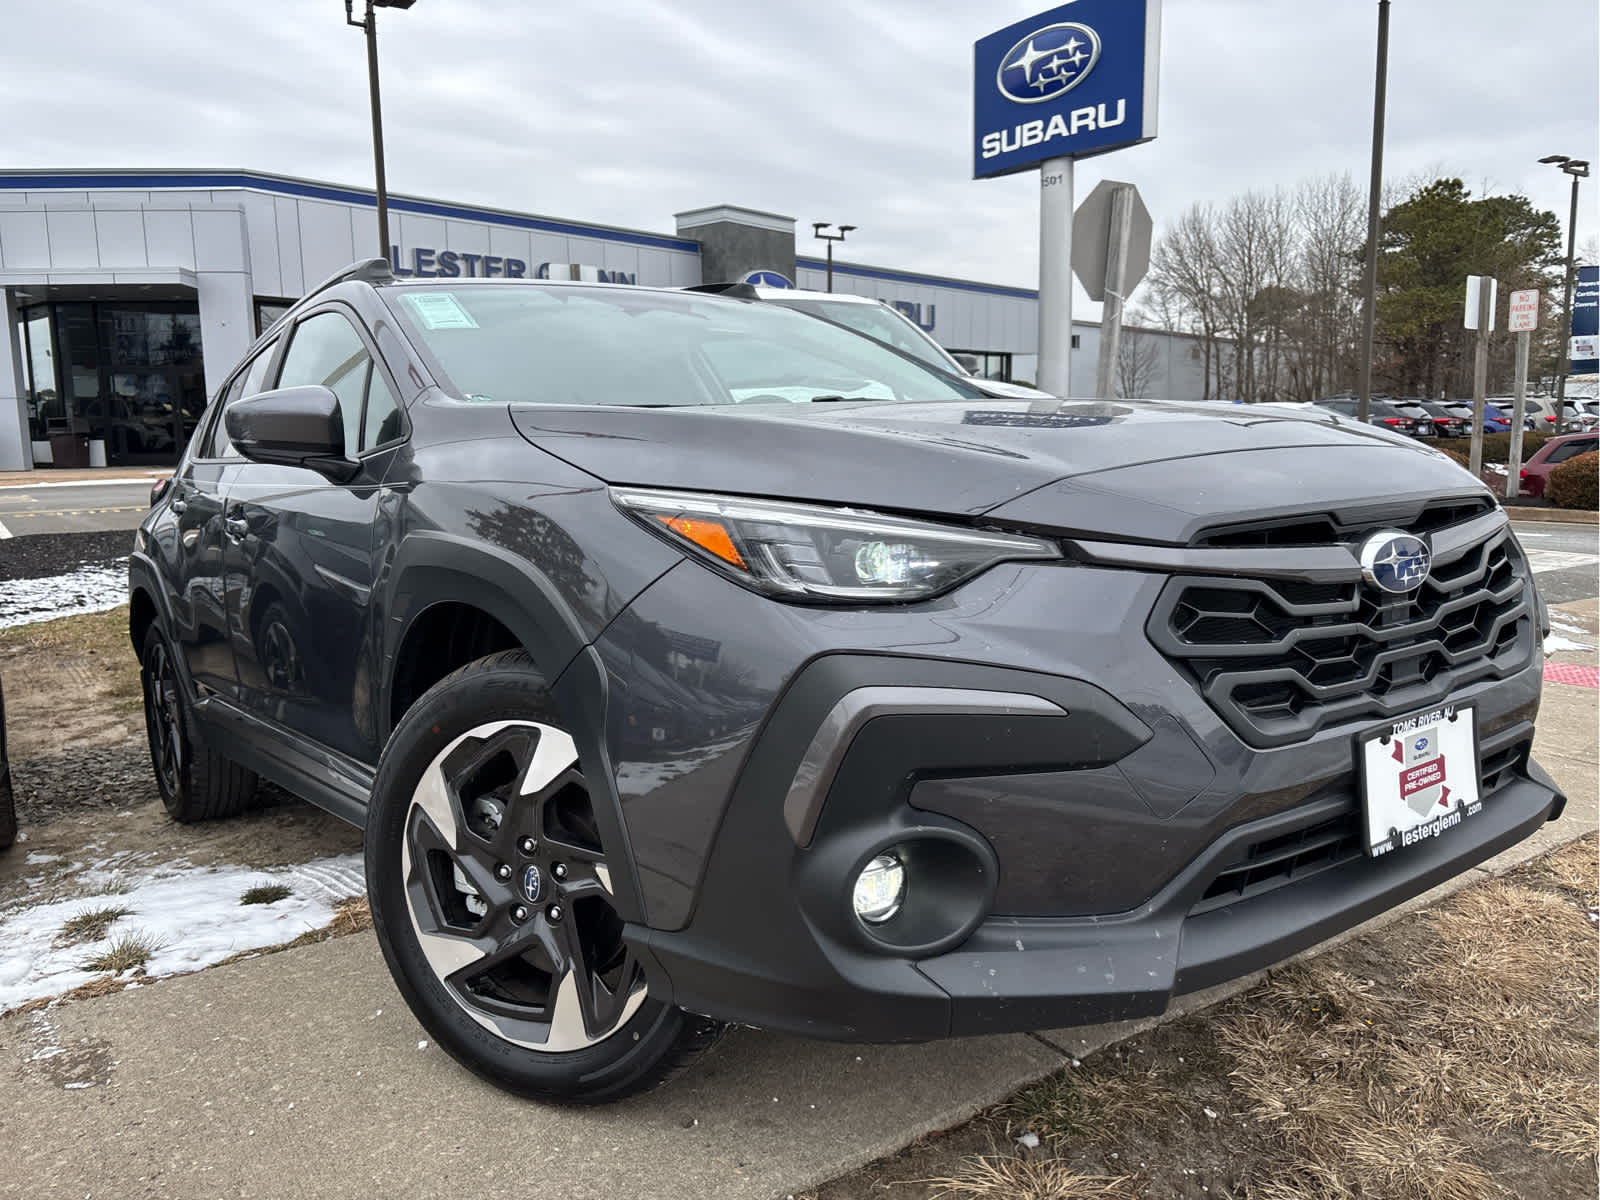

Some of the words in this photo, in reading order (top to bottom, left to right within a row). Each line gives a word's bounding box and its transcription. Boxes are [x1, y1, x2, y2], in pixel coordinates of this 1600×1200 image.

[982, 98, 1126, 159] SUBARU
[392, 245, 526, 278] LESTER
[1392, 718, 1416, 734] TOMS
[1443, 705, 1455, 720] NJ
[1404, 771, 1441, 792] PRE-OWNED
[1407, 763, 1438, 781] CERTIFIED
[1401, 811, 1461, 847] lesterglenn
